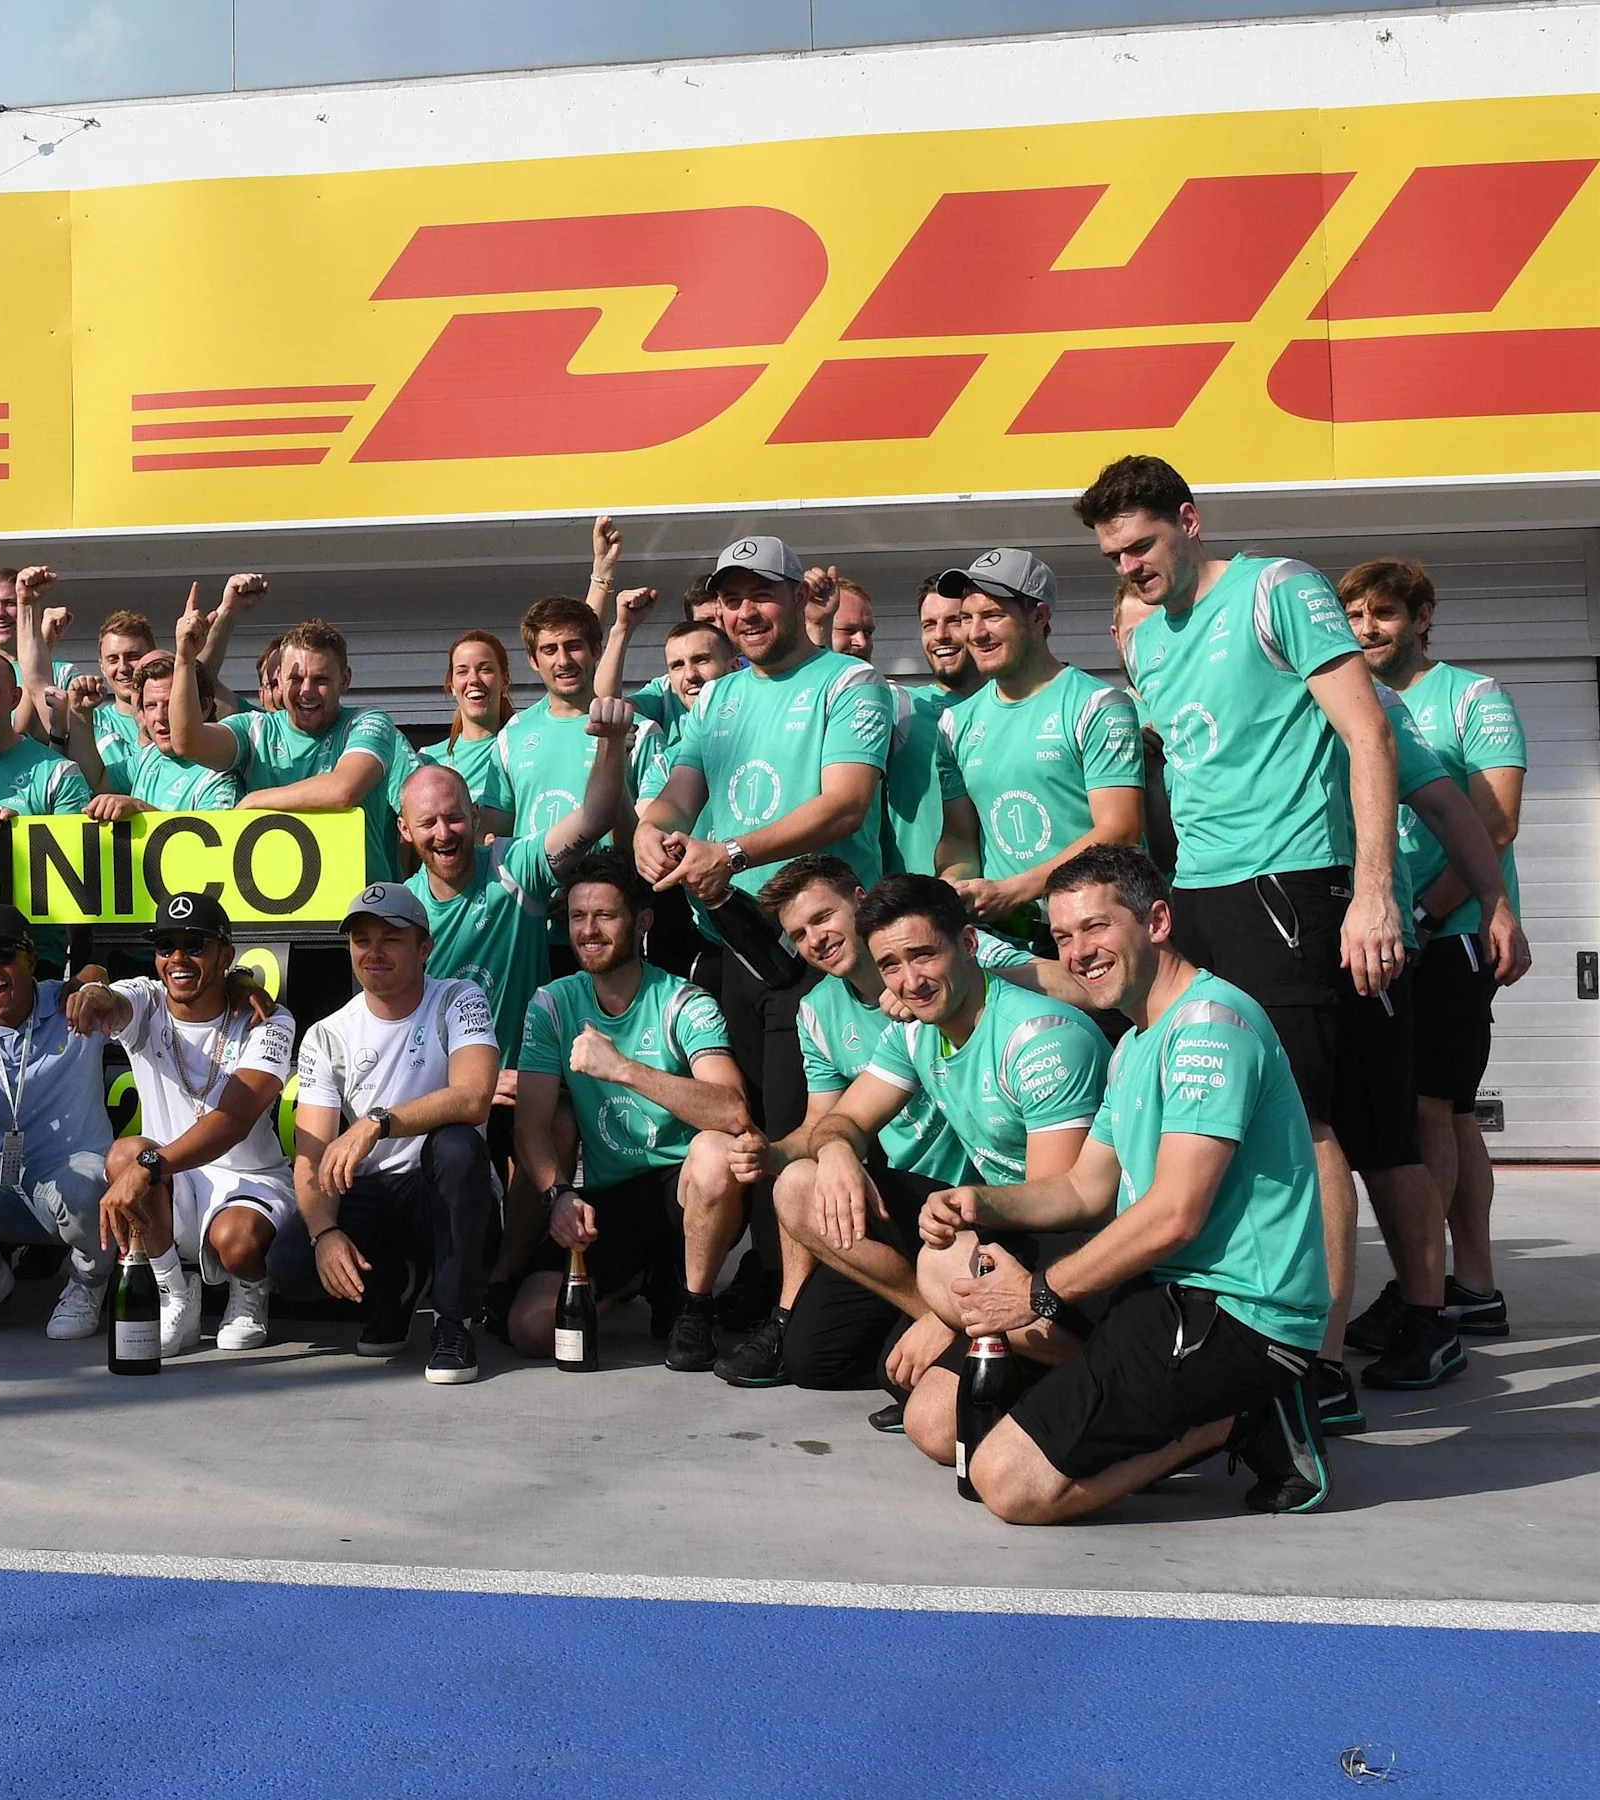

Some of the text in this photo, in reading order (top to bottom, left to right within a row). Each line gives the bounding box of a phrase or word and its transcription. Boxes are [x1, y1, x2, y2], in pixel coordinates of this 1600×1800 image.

[351, 159, 1600, 463] DHL
[1483, 713, 1515, 724] EPSON
[1036, 751, 1061, 759] BOSS
[535, 789, 575, 803] GP WINNERS
[746, 773, 759, 810] 1
[1001, 790, 1037, 805] WINNERS
[546, 801, 560, 825] 1
[743, 817, 760, 826] 2016
[1008, 804, 1025, 843] 1
[1014, 849, 1034, 860] 2016
[30, 813, 322, 916] NICO
[1175, 1038, 1230, 1052] QUALCOMM
[1015, 1040, 1062, 1069] QUALCOMM
[1175, 1054, 1223, 1069] EPSON
[1019, 1053, 1062, 1081] EPSON
[1019, 1071, 1054, 1092] Allianz
[1172, 1072, 1208, 1084] Allianz
[1178, 1086, 1210, 1101] IWC
[622, 1147, 644, 1156] 2016
